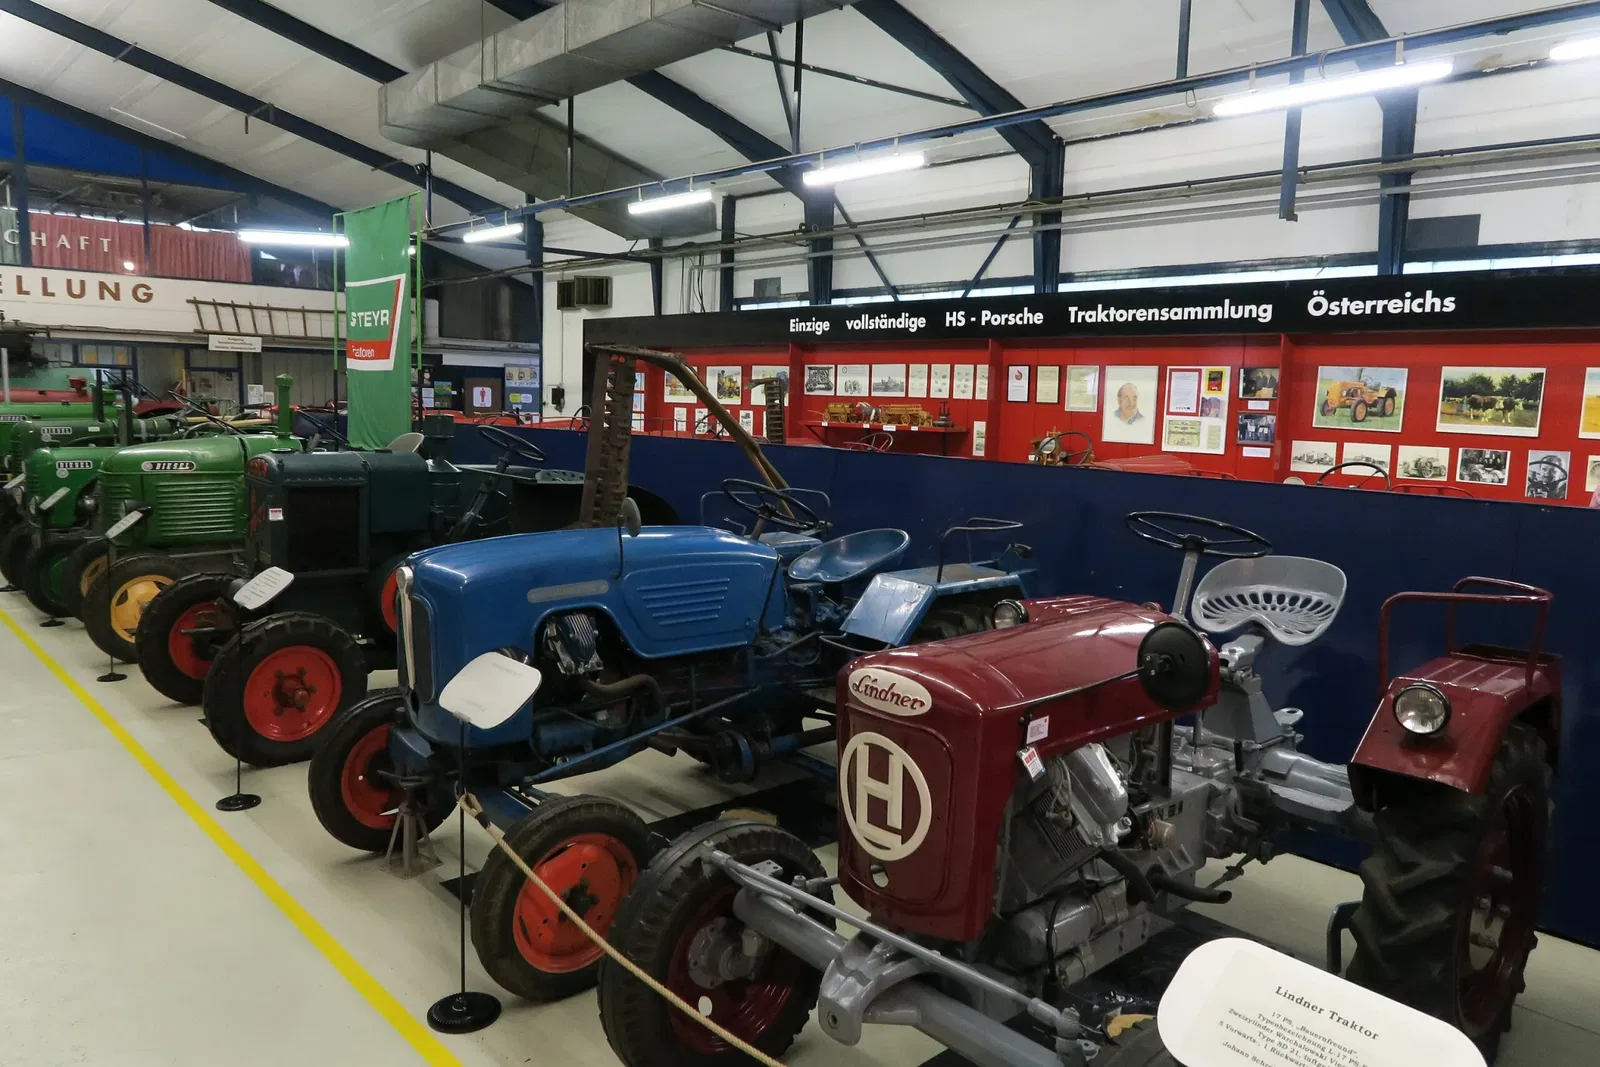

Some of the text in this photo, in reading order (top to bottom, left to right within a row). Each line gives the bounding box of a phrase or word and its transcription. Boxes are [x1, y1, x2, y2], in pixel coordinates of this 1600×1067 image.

[0, 274, 154, 303] LLUNG
[350, 309, 390, 327] STEYR
[789, 317, 830, 335] Einzige
[846, 312, 926, 332] vollständige
[945, 311, 966, 327] HS
[981, 307, 1044, 326] Porsche
[1068, 299, 1273, 323] Traktorensammlung
[1307, 290, 1456, 316] Österreichs
[852, 674, 926, 710] Lindner
[1275, 986, 1379, 1040] Lindner Traktor
[1222, 1041, 1250, 1058] Johann
[1228, 1008, 1273, 1034] Zweizylinder
[1276, 1031, 1327, 1061] Warchalowski
[1257, 1013, 1326, 1052] Typenbezeichnung
[1257, 1031, 1275, 1043] Type
[1276, 1040, 1288, 1050] SD
